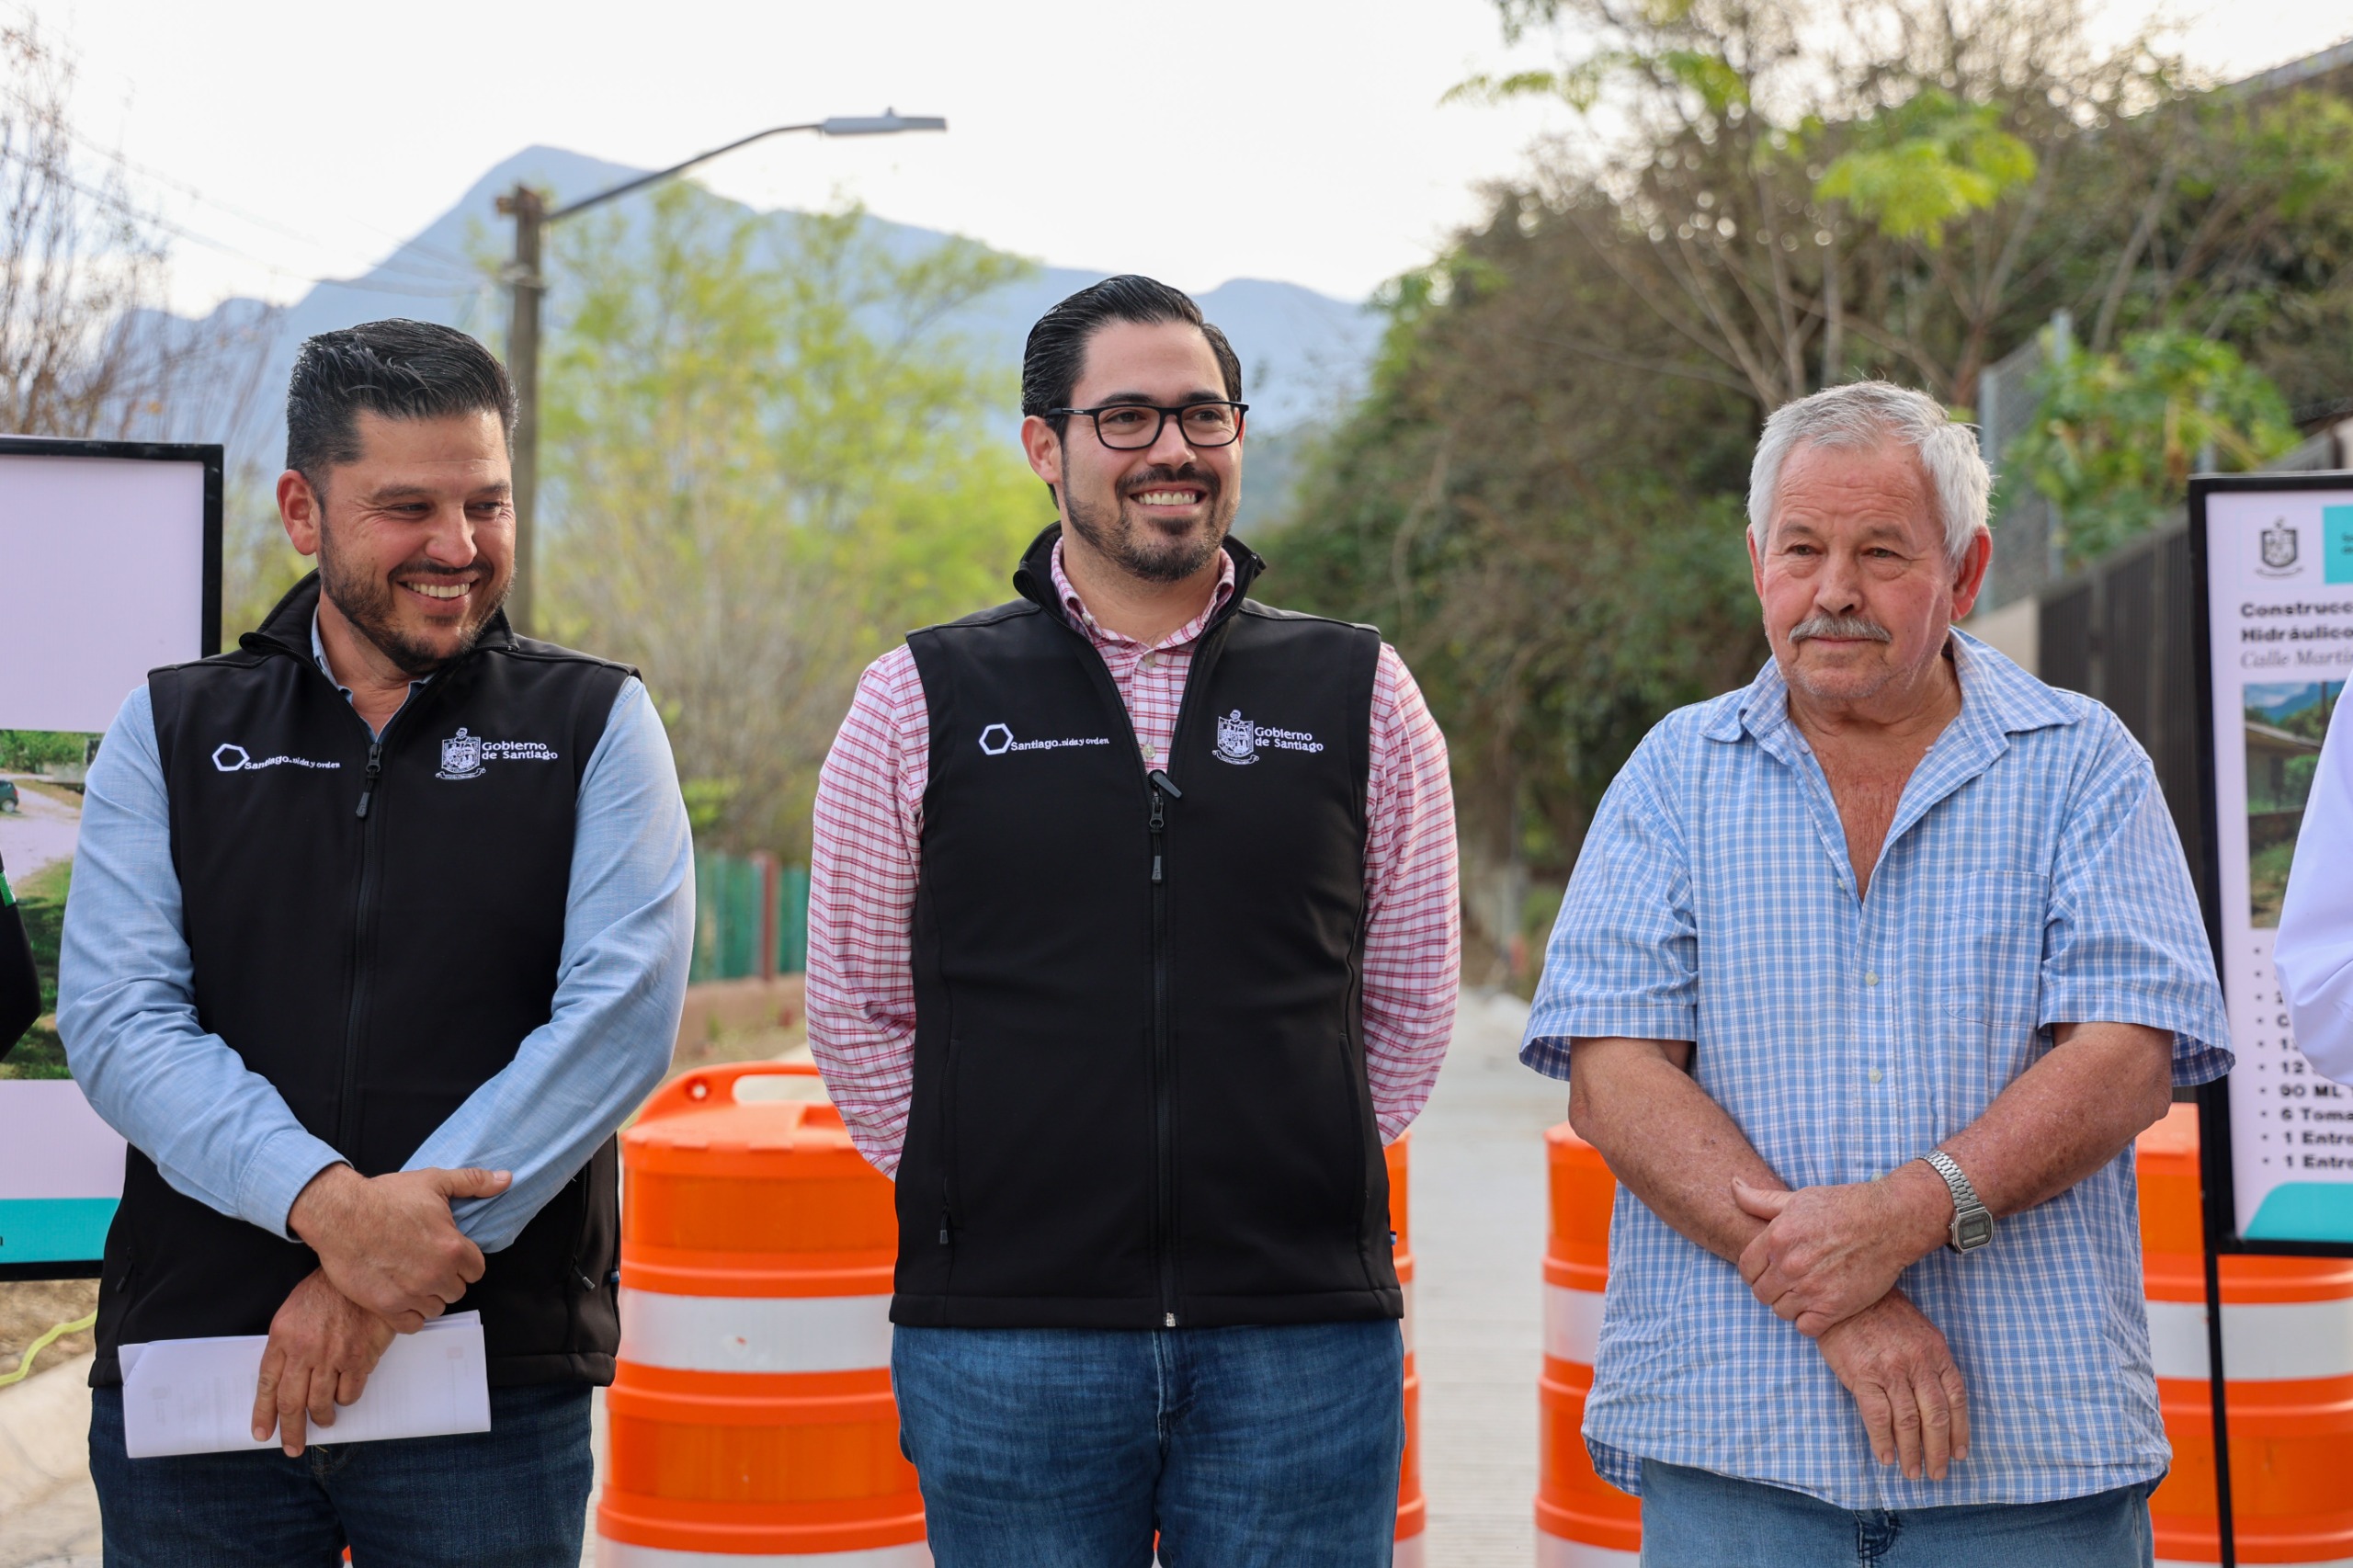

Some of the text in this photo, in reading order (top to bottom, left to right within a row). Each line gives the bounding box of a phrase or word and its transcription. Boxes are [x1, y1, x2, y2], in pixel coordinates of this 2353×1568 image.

[2241, 646, 2353, 669] Calle Martí
[1086, 736, 1109, 745] orden
[1254, 726, 1313, 742] Gobierno
[481, 741, 548, 751] Gobierno
[1255, 738, 1324, 753] de Santiago
[481, 749, 559, 761] de Santiago
[2281, 1061, 2304, 1074] 12
[2279, 1085, 2342, 1098] 90 ML
[2280, 1108, 2293, 1121] 6
[2283, 1131, 2293, 1144] 1
[2285, 1155, 2294, 1168] 1
